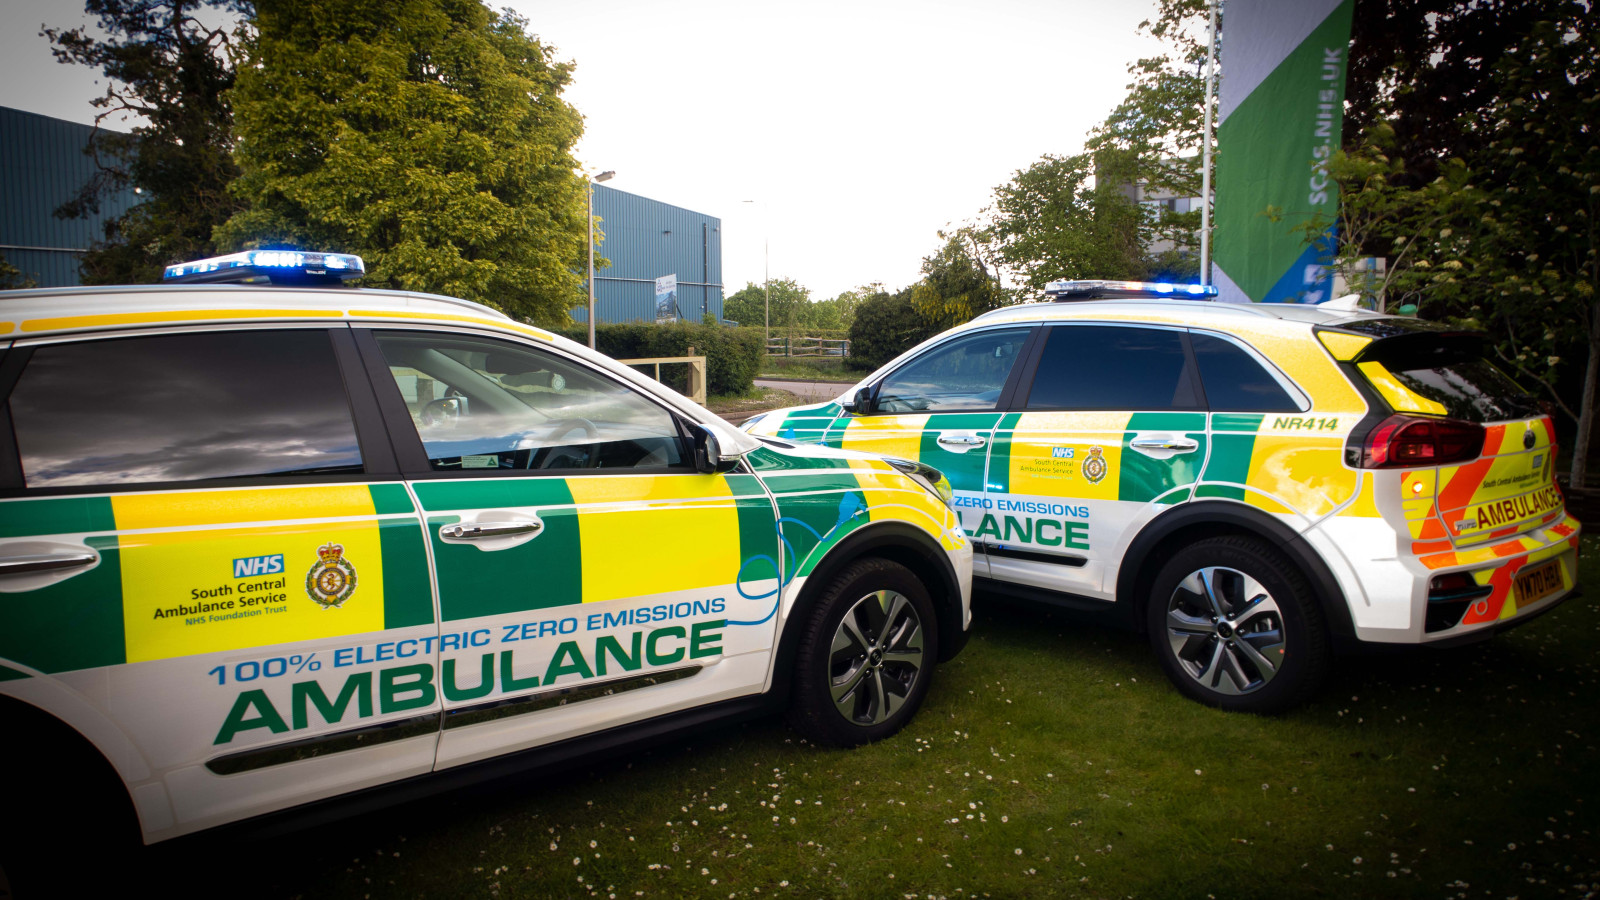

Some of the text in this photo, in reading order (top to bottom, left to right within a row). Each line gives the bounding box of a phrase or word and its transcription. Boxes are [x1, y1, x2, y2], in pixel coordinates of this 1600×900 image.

[1272, 417, 1338, 430] NR414
[1052, 447, 1074, 459] NHS
[954, 496, 1090, 518] ZERO EMISSIONS
[1477, 487, 1559, 529] AMBULANCE
[233, 554, 284, 578] NHS
[191, 577, 286, 600] South Central
[153, 591, 287, 620] Ambulance Service
[185, 605, 287, 626] NHS Foundation Trust
[208, 597, 726, 686] 100% ELECTRIC ZERO EMISSIONS
[213, 618, 729, 746] AMBULANCE
